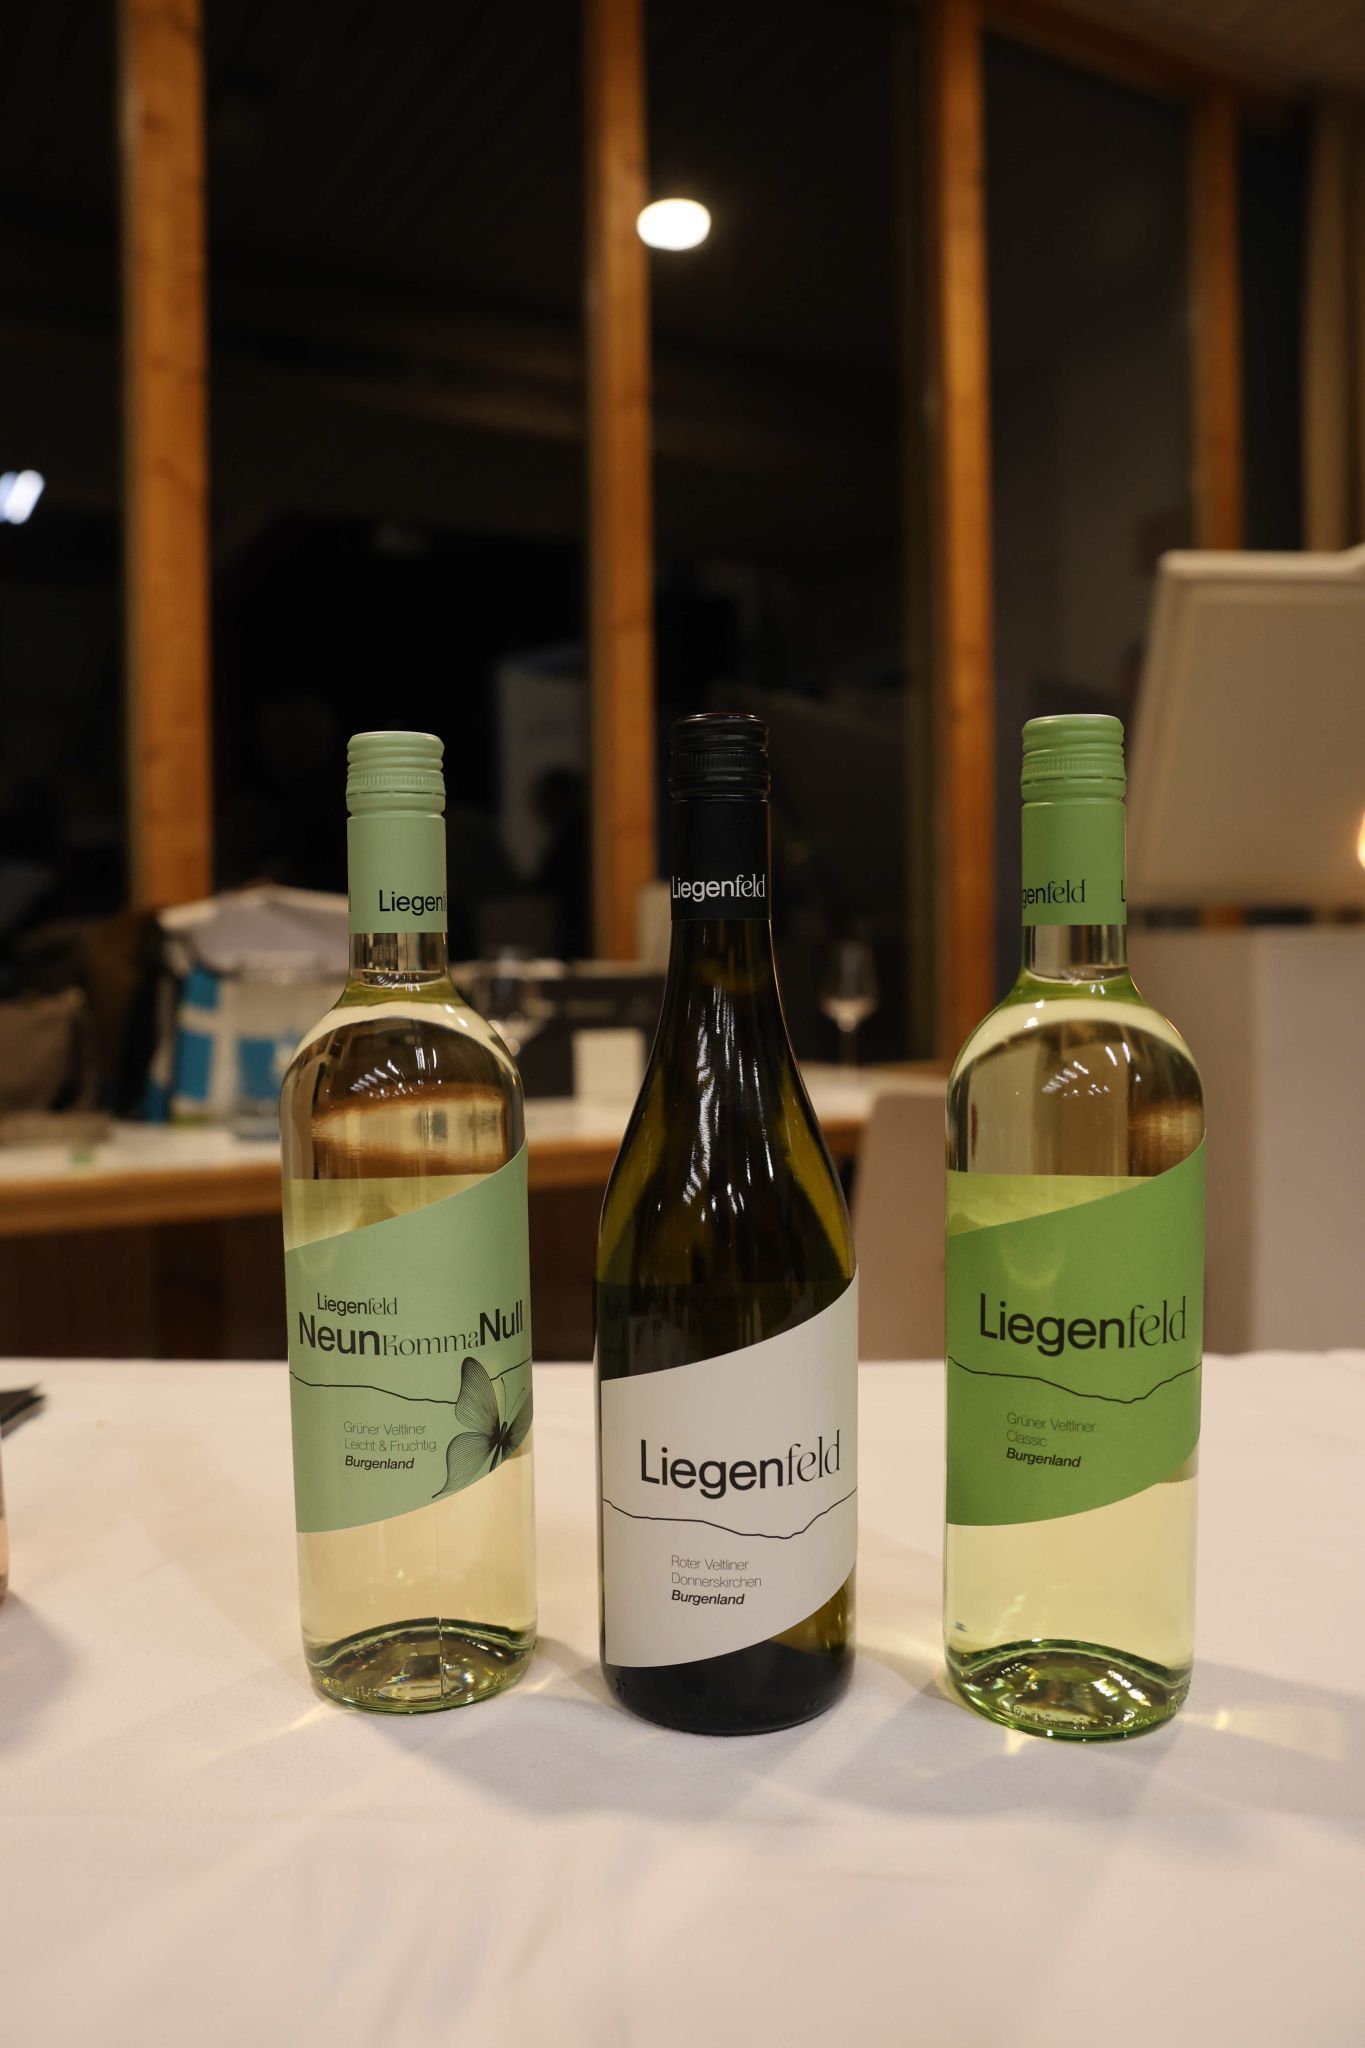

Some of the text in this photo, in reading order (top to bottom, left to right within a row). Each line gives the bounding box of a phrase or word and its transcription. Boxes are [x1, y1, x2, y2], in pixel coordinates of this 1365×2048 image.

[672, 873, 766, 902] Liegenfeld
[378, 889, 447, 916] Liegen
[317, 1292, 398, 1316] Liegenfeld
[980, 1293, 1187, 1357] Liegenfeld
[343, 1420, 426, 1436] Grüner Veltliner
[1006, 1411, 1096, 1433] Grüner Veltliner
[344, 1437, 437, 1453] Leicht & Fruchtig
[1006, 1429, 1048, 1448] Classic
[345, 1455, 415, 1471] Burgenland
[640, 1429, 841, 1500] Liegenfeld
[1006, 1447, 1082, 1468] Burgenland
[671, 1554, 749, 1571] Roter Veltliner
[671, 1571, 762, 1588] Donnerskirchen
[671, 1589, 745, 1606] Burgenland
